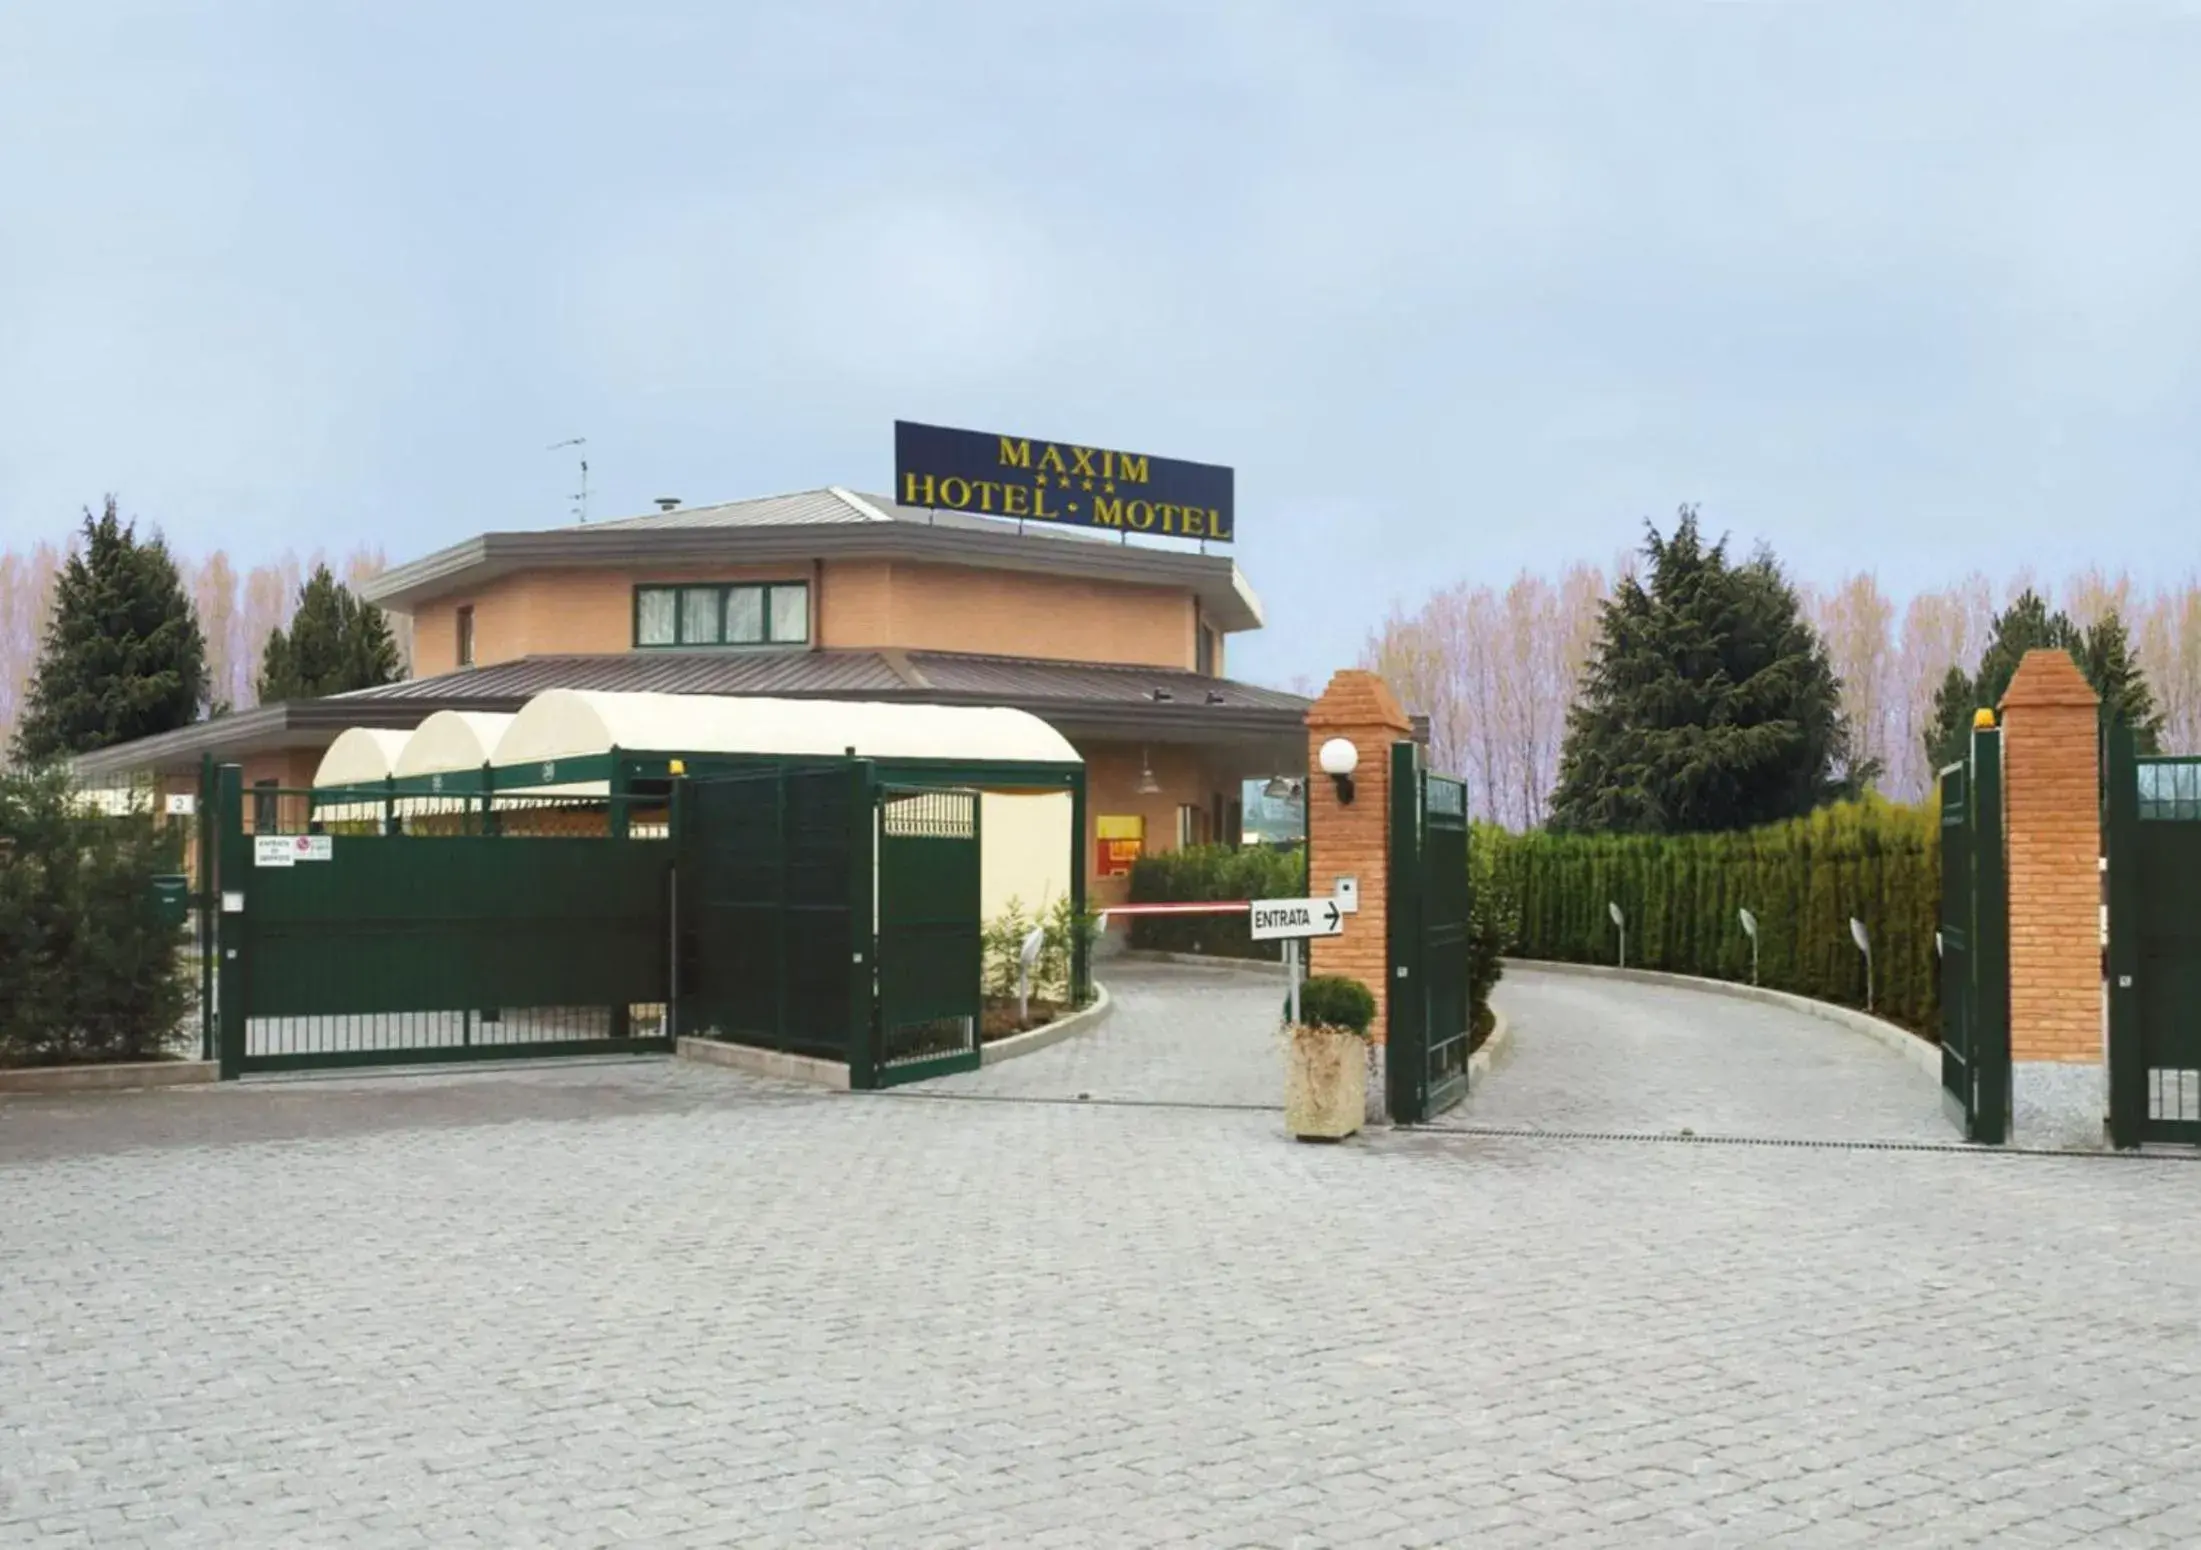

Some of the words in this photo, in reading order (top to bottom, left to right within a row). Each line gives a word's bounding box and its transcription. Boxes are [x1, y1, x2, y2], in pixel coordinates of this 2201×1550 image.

[999, 435, 1149, 483] MAXIM
[904, 472, 1059, 518] HOTEL
[1092, 495, 1232, 538] MOTEL
[1255, 909, 1310, 928] ENTRATA
